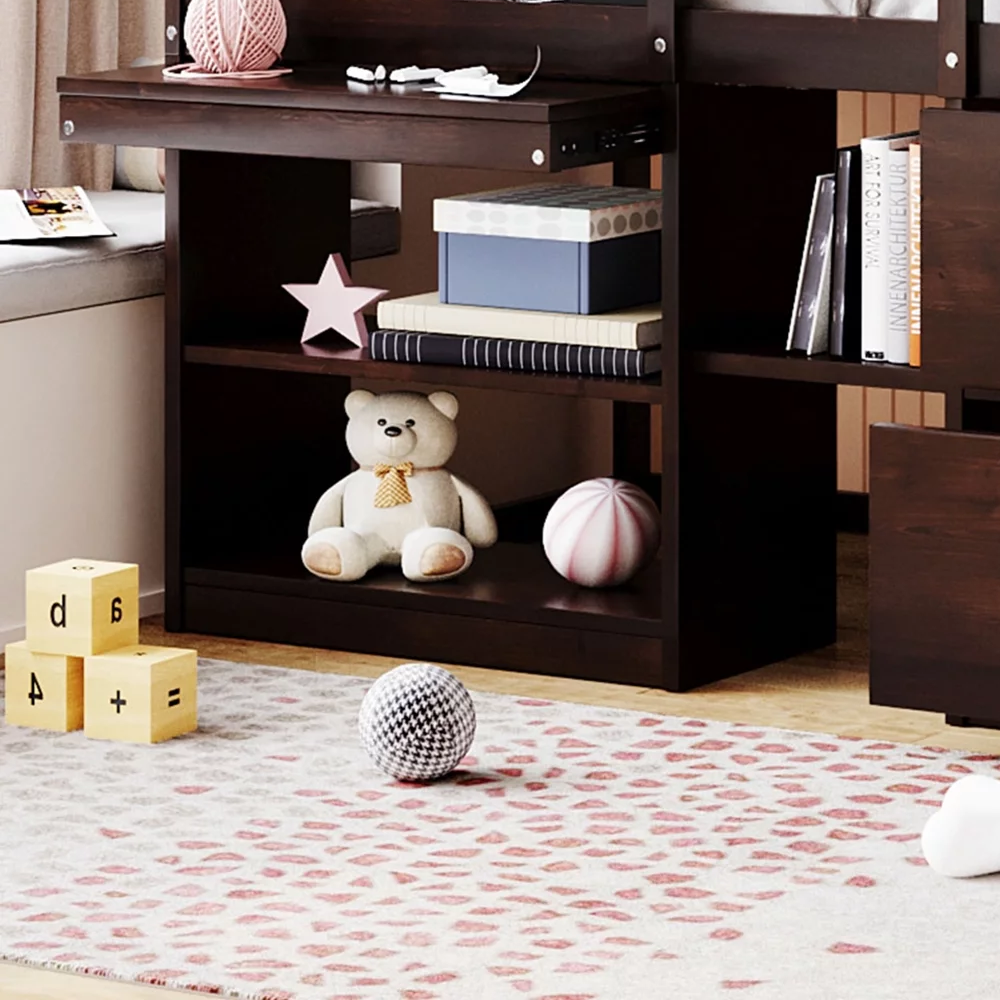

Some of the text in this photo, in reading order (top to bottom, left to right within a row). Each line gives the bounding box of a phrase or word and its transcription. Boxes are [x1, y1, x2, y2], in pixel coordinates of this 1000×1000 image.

[864, 152, 881, 177] ART
[864, 182, 882, 208] FOR
[888, 163, 908, 332] INNENARCHITEKTUR
